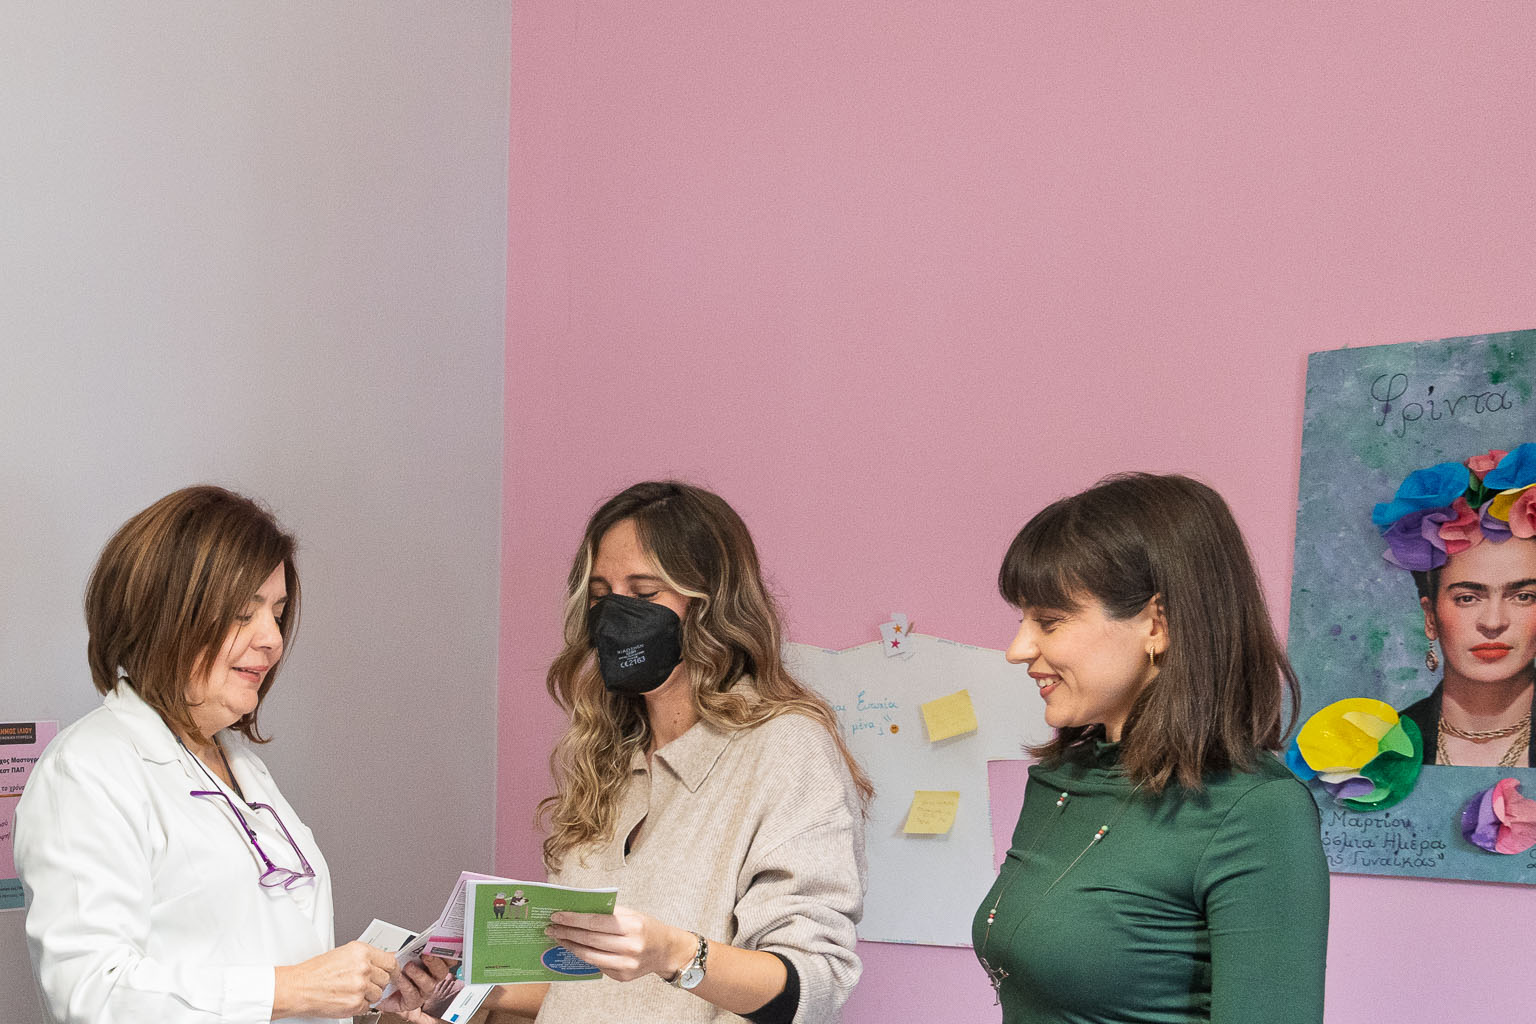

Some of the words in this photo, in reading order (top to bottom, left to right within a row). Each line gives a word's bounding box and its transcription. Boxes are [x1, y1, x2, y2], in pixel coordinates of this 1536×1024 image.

[1328, 810, 1412, 833] Μαρτίου
[1322, 831, 1376, 853] όσμια
[1383, 832, 1446, 856] Ημέρα
